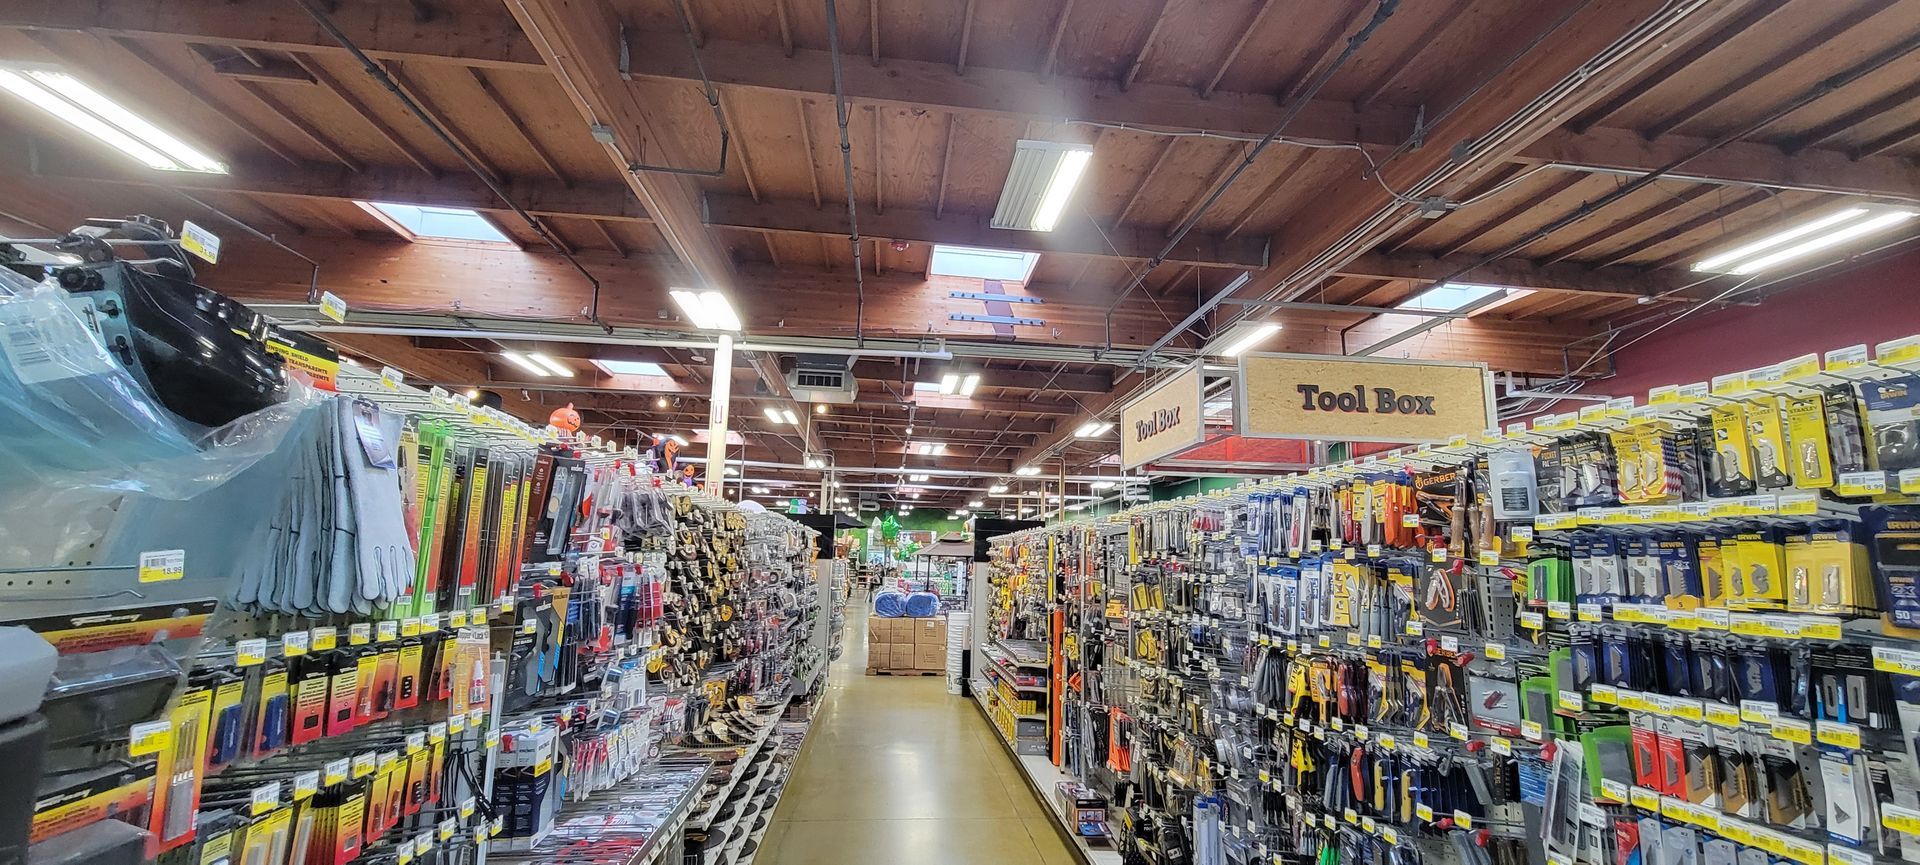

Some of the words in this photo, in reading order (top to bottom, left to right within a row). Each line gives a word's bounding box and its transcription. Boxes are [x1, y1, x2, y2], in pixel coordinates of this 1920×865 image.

[1297, 384, 1368, 413] Tool
[1374, 387, 1437, 416] Box
[1750, 408, 1775, 417] STANLEY
[1789, 405, 1817, 414] STANLEY
[1135, 412, 1158, 443] Tool
[1158, 405, 1181, 435] Box
[1714, 416, 1739, 425] STANLEY
[1573, 440, 1598, 450] STANLEY
[1423, 472, 1457, 486] GERBER
[1737, 533, 1761, 541] IRWIN
[162, 566, 182, 576] 18.99
[1894, 609, 1911, 620] 50
